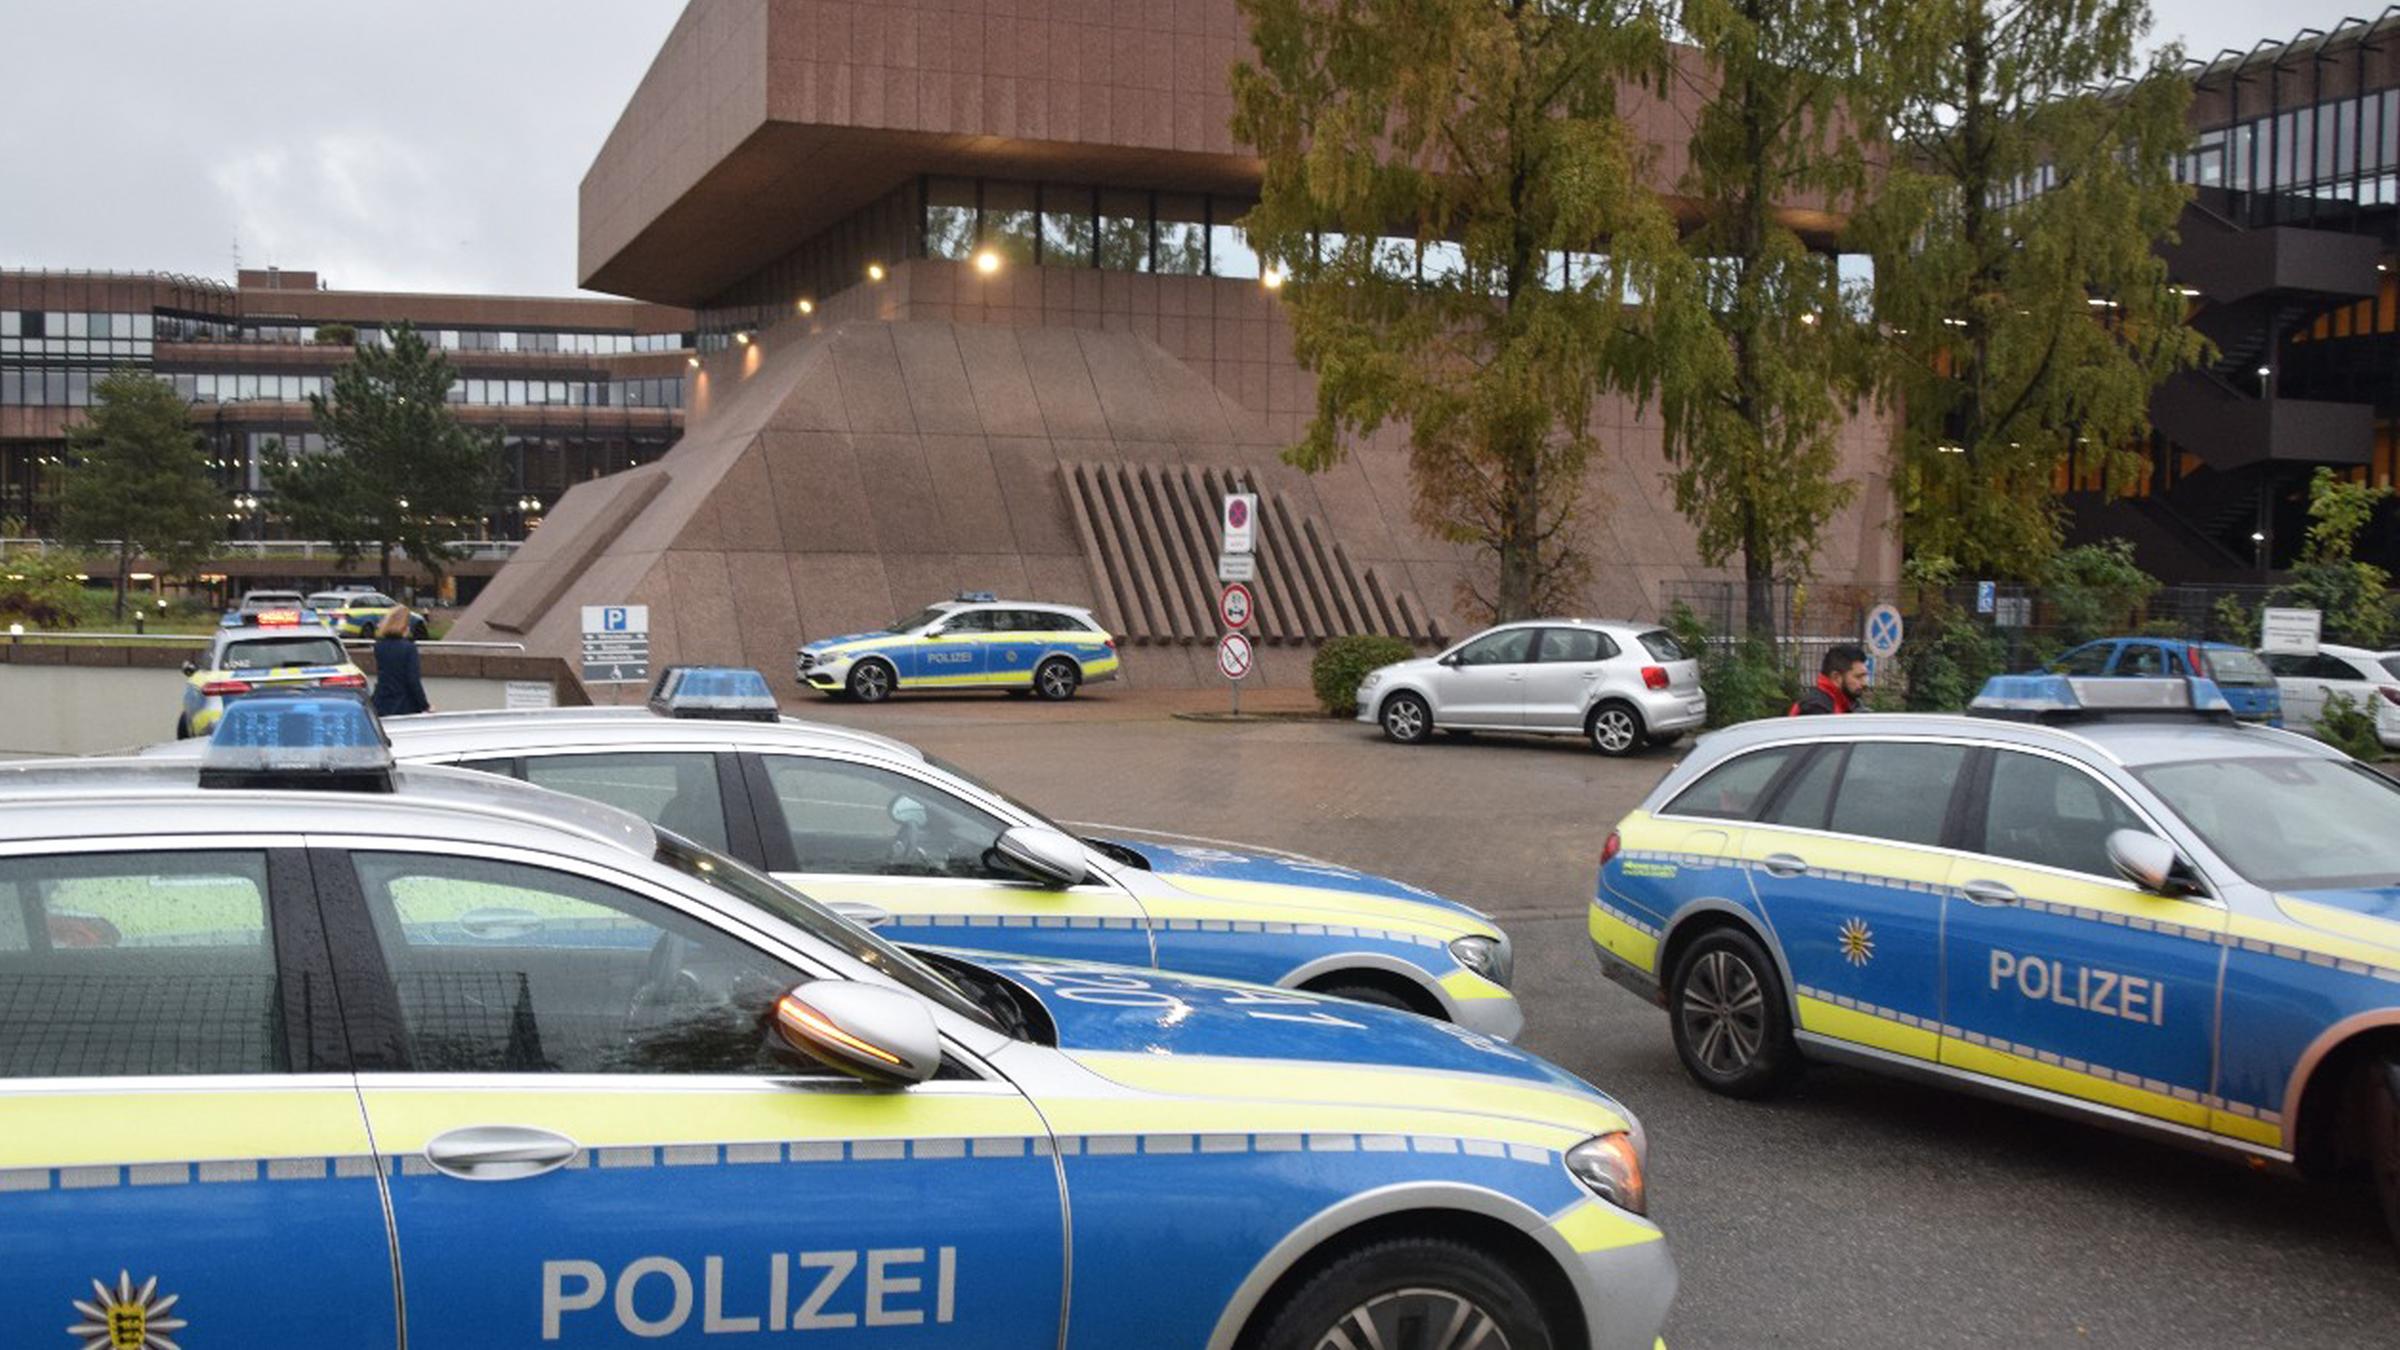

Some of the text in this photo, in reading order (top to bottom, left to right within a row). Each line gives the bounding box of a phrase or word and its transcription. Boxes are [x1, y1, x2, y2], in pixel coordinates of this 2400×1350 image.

[608, 609, 623, 630] P
[1989, 948, 2164, 1026] POLIZEI
[541, 1246, 957, 1340] POLIZEI
